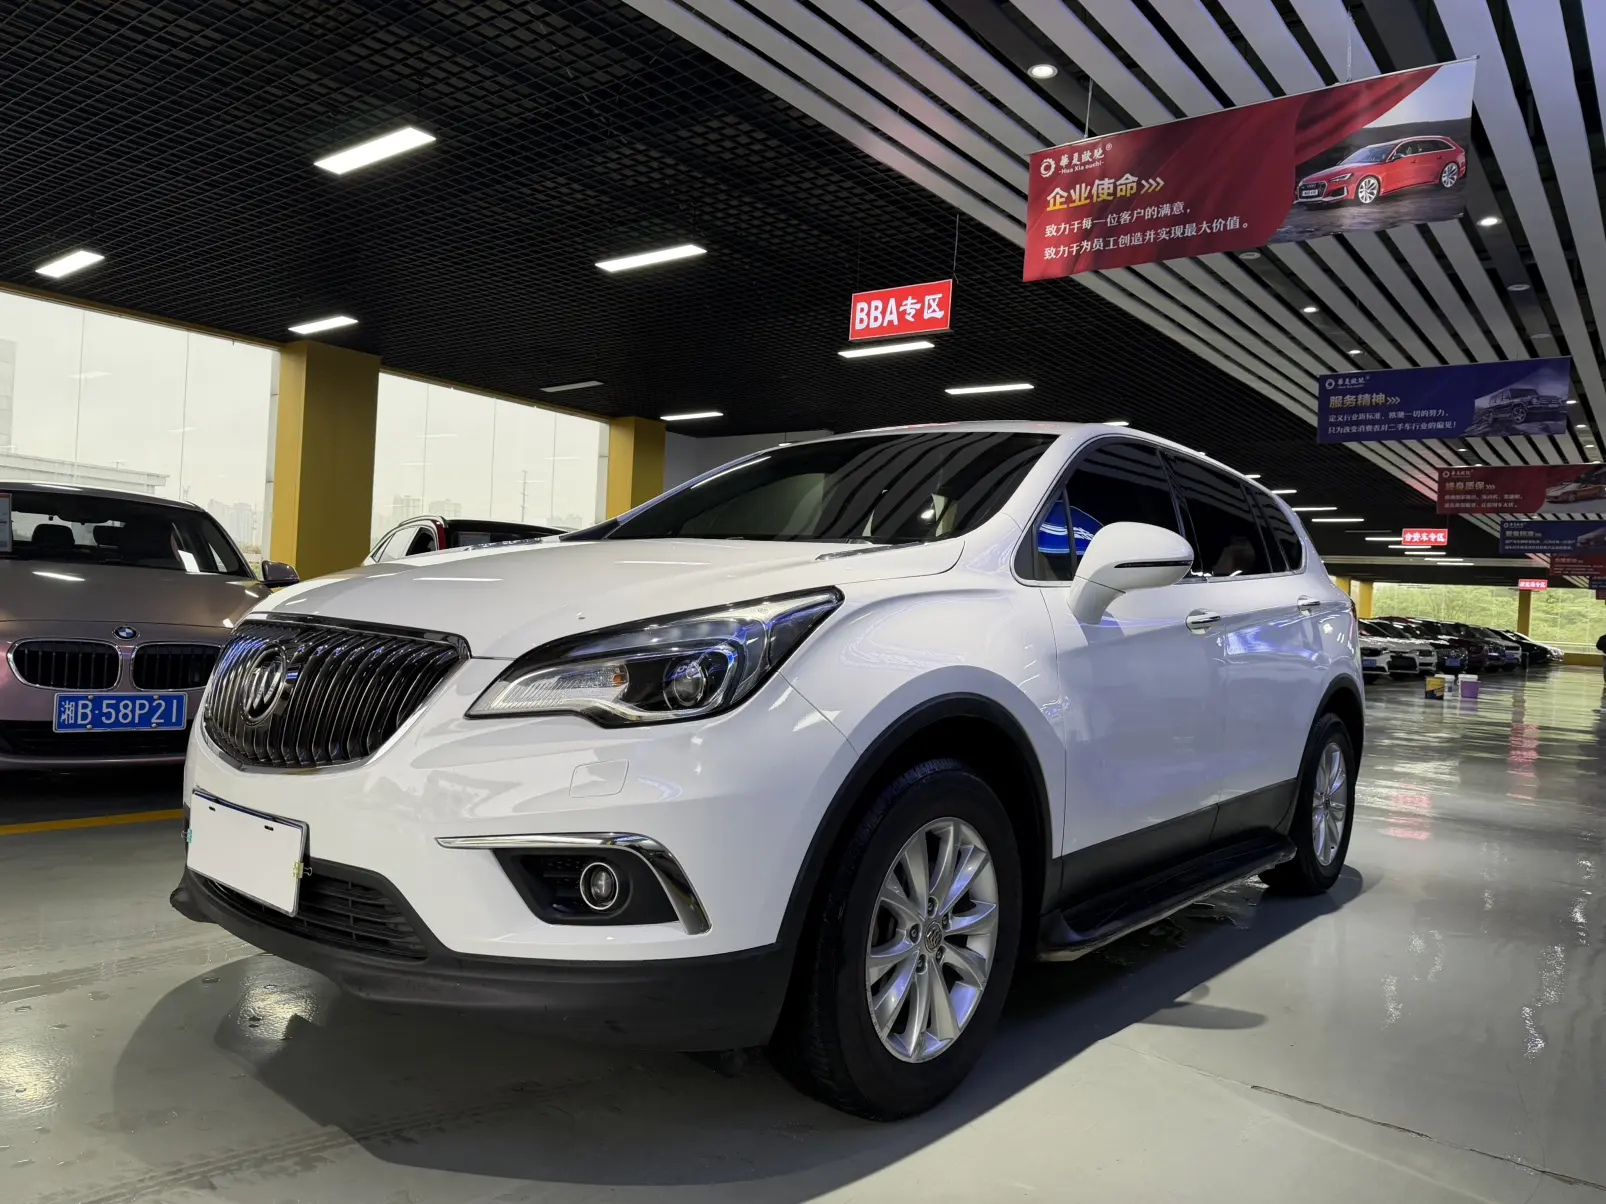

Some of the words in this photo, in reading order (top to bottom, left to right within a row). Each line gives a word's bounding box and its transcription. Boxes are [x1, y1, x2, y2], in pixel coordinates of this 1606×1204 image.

[1046, 173, 1138, 211] 企业使命
[1043, 215, 1249, 260] 致力于为员工创造并实现最大价值。
[1044, 201, 1191, 238] 致力于每一位客户的满意，
[855, 293, 945, 330] BBA专区
[1329, 392, 1386, 409] 服务精神
